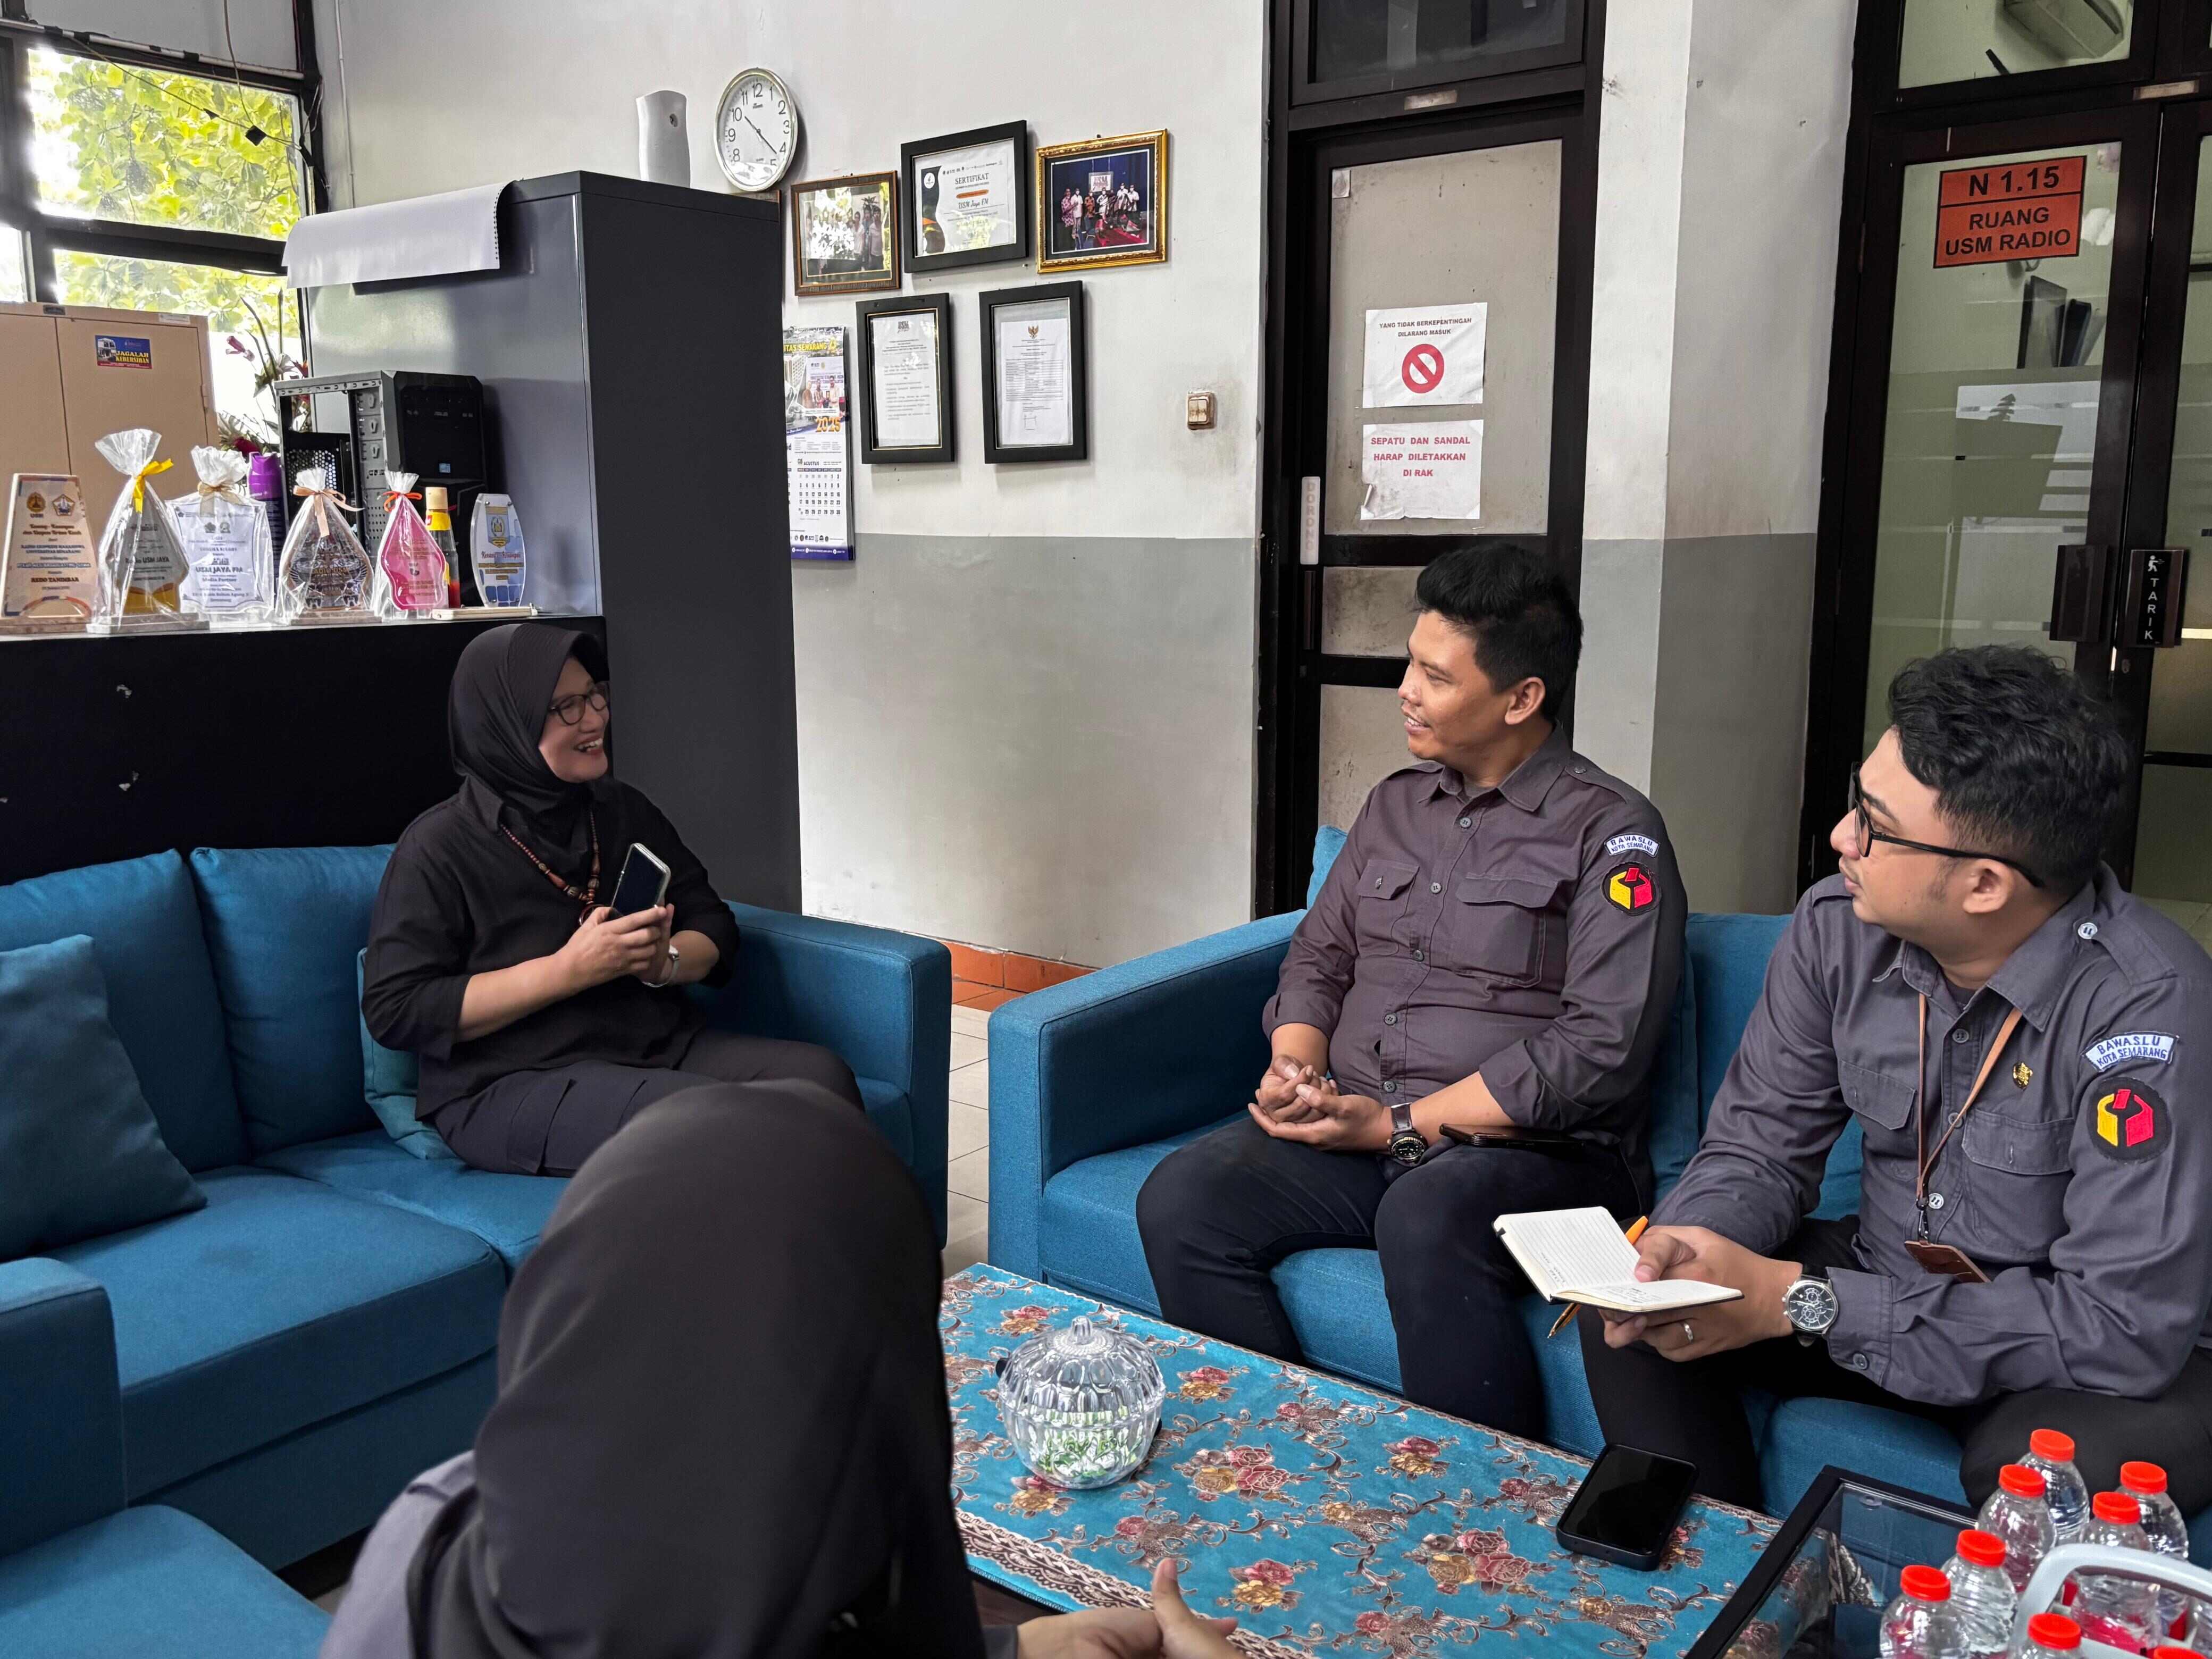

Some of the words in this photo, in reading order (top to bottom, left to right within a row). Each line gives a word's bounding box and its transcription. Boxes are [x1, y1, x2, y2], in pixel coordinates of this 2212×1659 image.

[741, 89, 748, 105] 11
[753, 83, 763, 98] 12
[769, 86, 773, 101] 1
[731, 107, 742, 122] 10
[778, 100, 786, 115] 2
[783, 120, 790, 134] 3
[728, 128, 736, 142] 9
[733, 148, 740, 162] 8
[780, 142, 786, 153] 4
[955, 173, 990, 185] SERTIFIKAT
[1970, 173, 1989, 197] N
[2001, 166, 2059, 192] 1.15
[1970, 207, 2049, 230] RUANG
[1946, 237, 1992, 256] USM
[2000, 229, 2071, 250] RADIO
[1417, 318, 1472, 326] BERKEPENTINGAN
[799, 342, 827, 351] SEMARANG
[816, 417, 841, 433] 2025
[2144, 578, 2159, 640] TARIK
[1610, 836, 1653, 845] BAWASLU
[2097, 1036, 2160, 1055] BAWASLU
[2097, 1052, 2117, 1066] KOTA
[2117, 1046, 2167, 1059] SEMARANG
